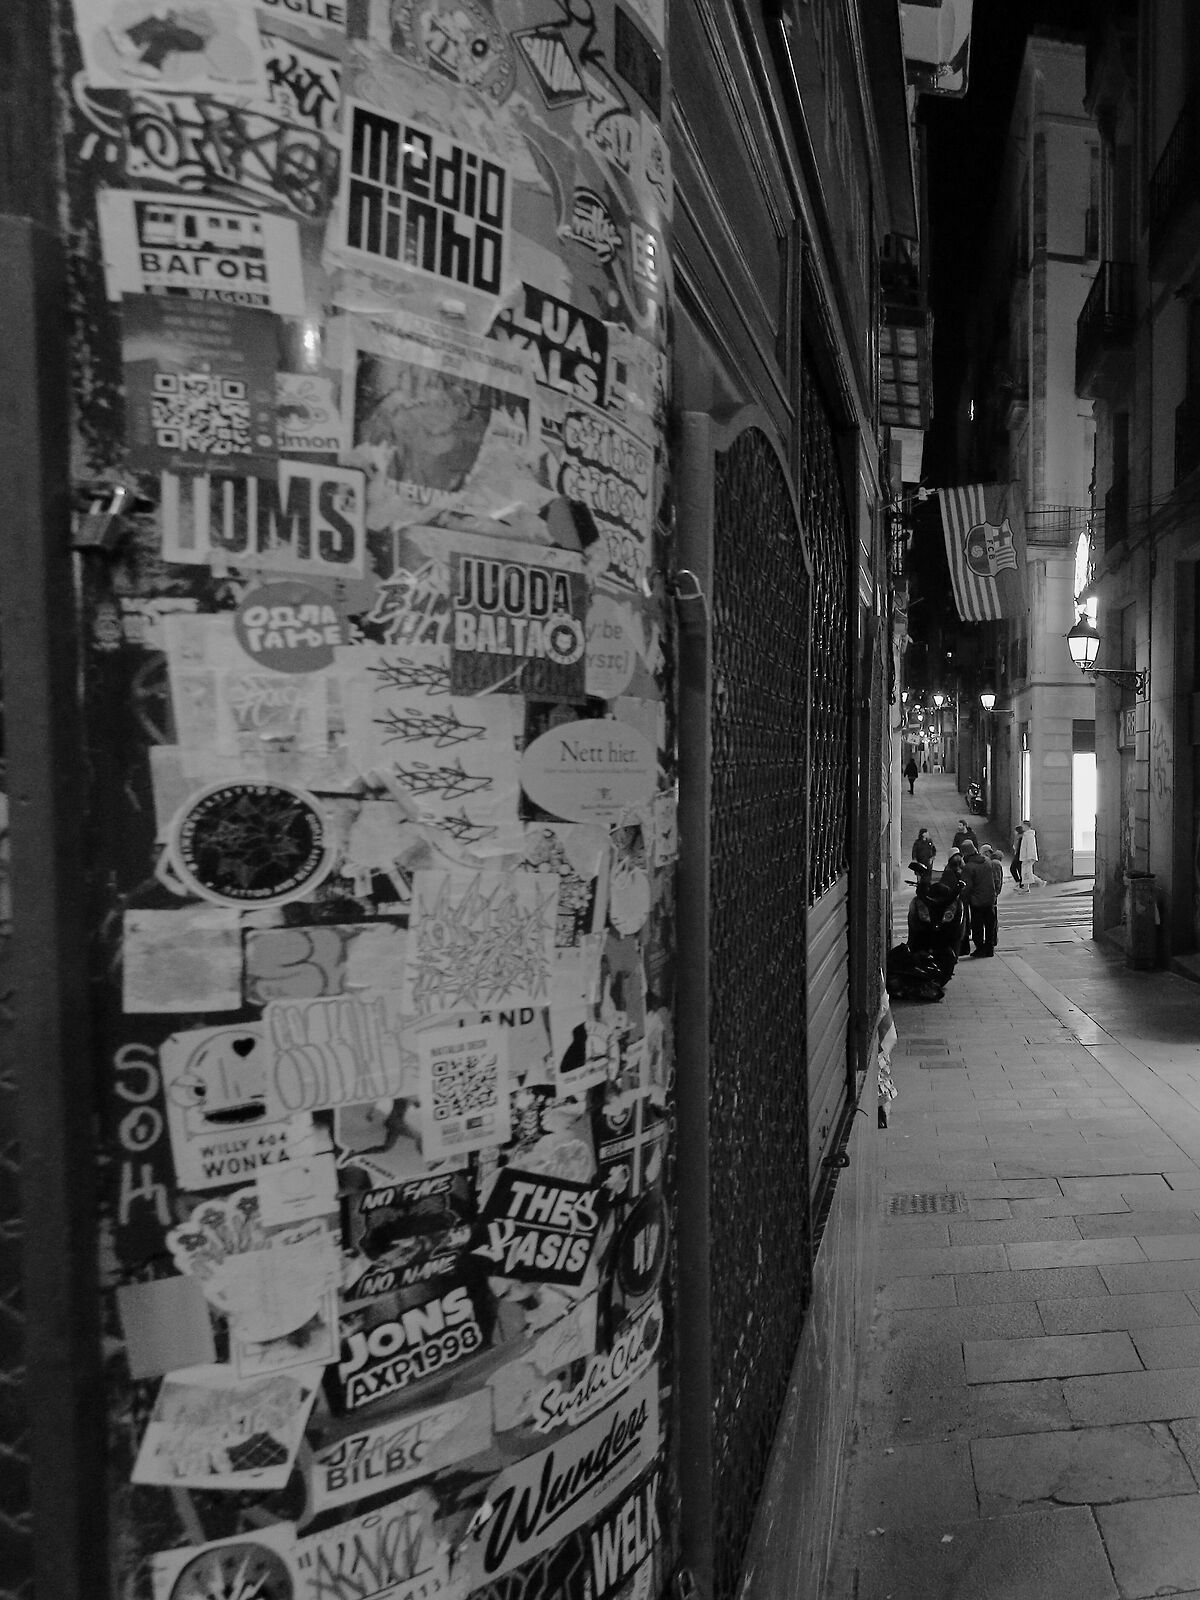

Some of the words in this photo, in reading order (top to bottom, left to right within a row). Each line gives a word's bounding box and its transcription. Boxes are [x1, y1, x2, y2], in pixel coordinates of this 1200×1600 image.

[263, 0, 344, 25] GLE
[351, 106, 506, 232] medio
[347, 178, 503, 296] ninho
[453, 556, 574, 619] JUODA
[454, 611, 547, 658] BALTA
[559, 740, 603, 762] Nett
[200, 1139, 249, 1158] WILLY
[202, 1149, 291, 1178] WONKA
[340, 1286, 476, 1384] JONS
[350, 1325, 480, 1402] AXP1998
